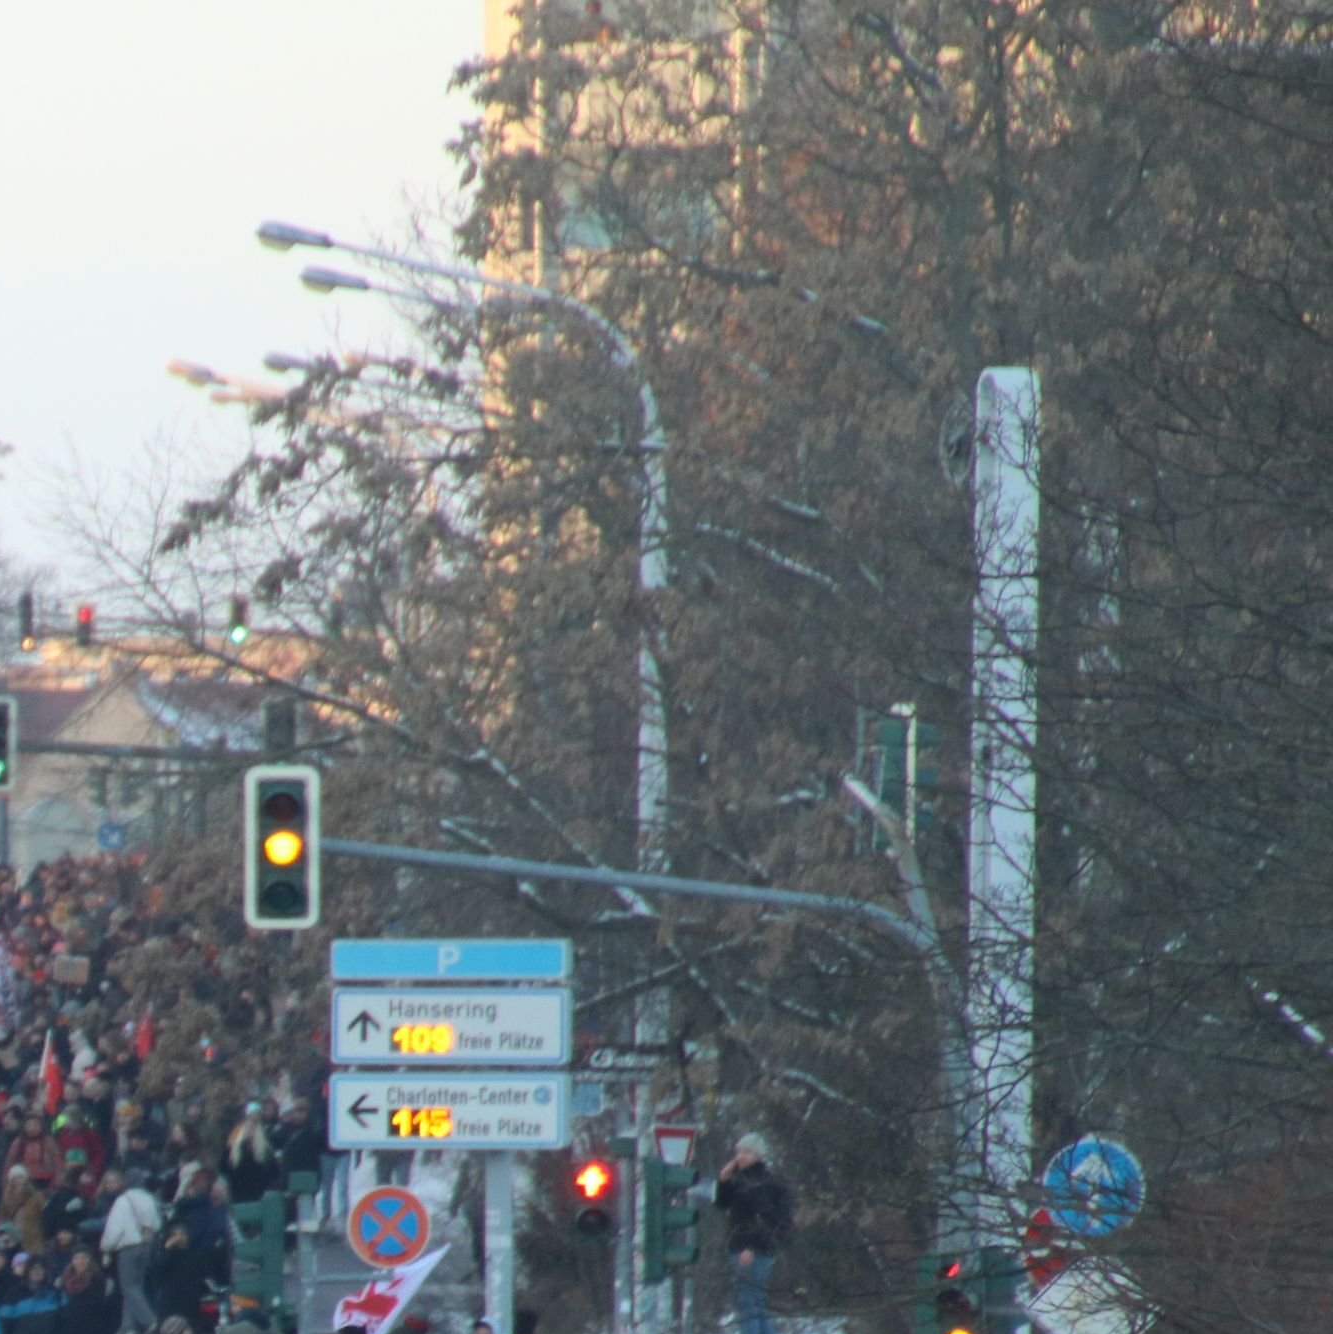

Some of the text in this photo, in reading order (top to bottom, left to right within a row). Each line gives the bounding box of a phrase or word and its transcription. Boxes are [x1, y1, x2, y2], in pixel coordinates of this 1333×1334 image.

[438, 946, 460, 973] P
[388, 999, 497, 1022] Hansering
[393, 1024, 544, 1054] 109 freie Plätze
[392, 1107, 542, 1138] 115 freie Plätze
